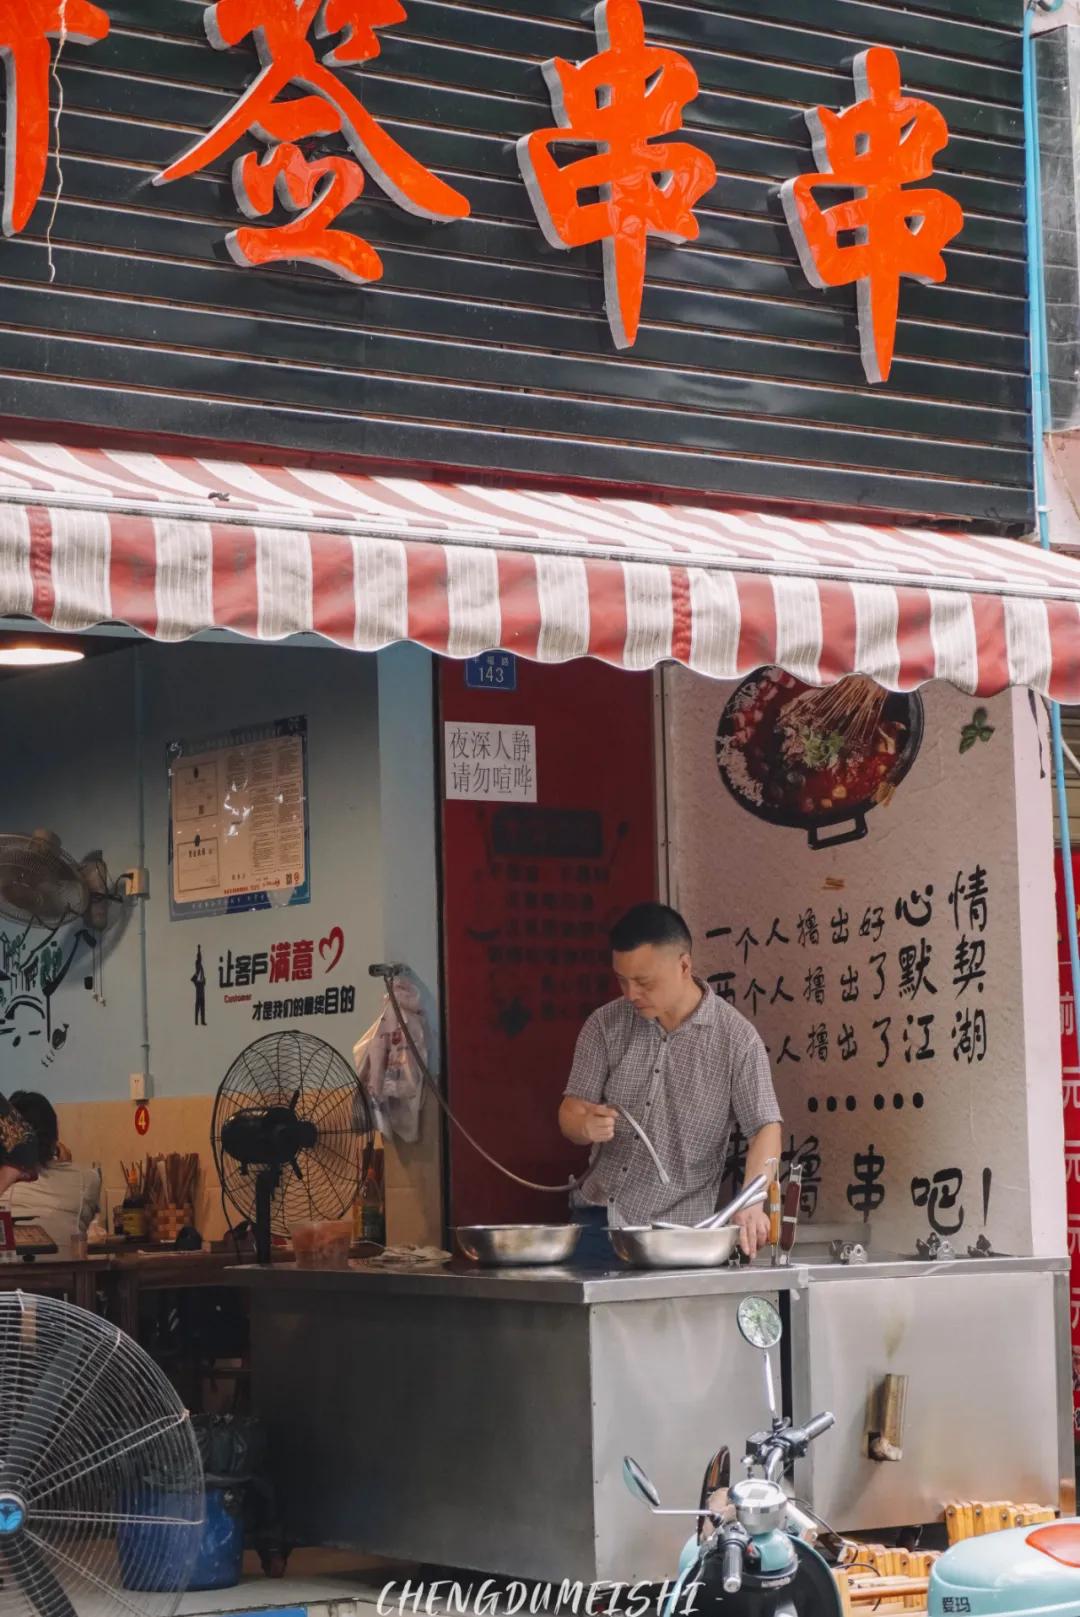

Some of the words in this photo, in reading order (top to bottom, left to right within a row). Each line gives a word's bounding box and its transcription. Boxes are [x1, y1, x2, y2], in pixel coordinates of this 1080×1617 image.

[479, 667, 504, 683] 143
[449, 728, 531, 762] 夜深人静
[452, 762, 533, 795] 请勿喧哗
[705, 864, 988, 964] 一个人撸出好心情
[218, 939, 314, 988] 让客户满意
[252, 985, 355, 1021] 才是我们的最终目的
[765, 1007, 987, 1068] 人撸出了江湖
[137, 1107, 146, 1129] 4
[942, 1597, 971, 1613] 爱玛
